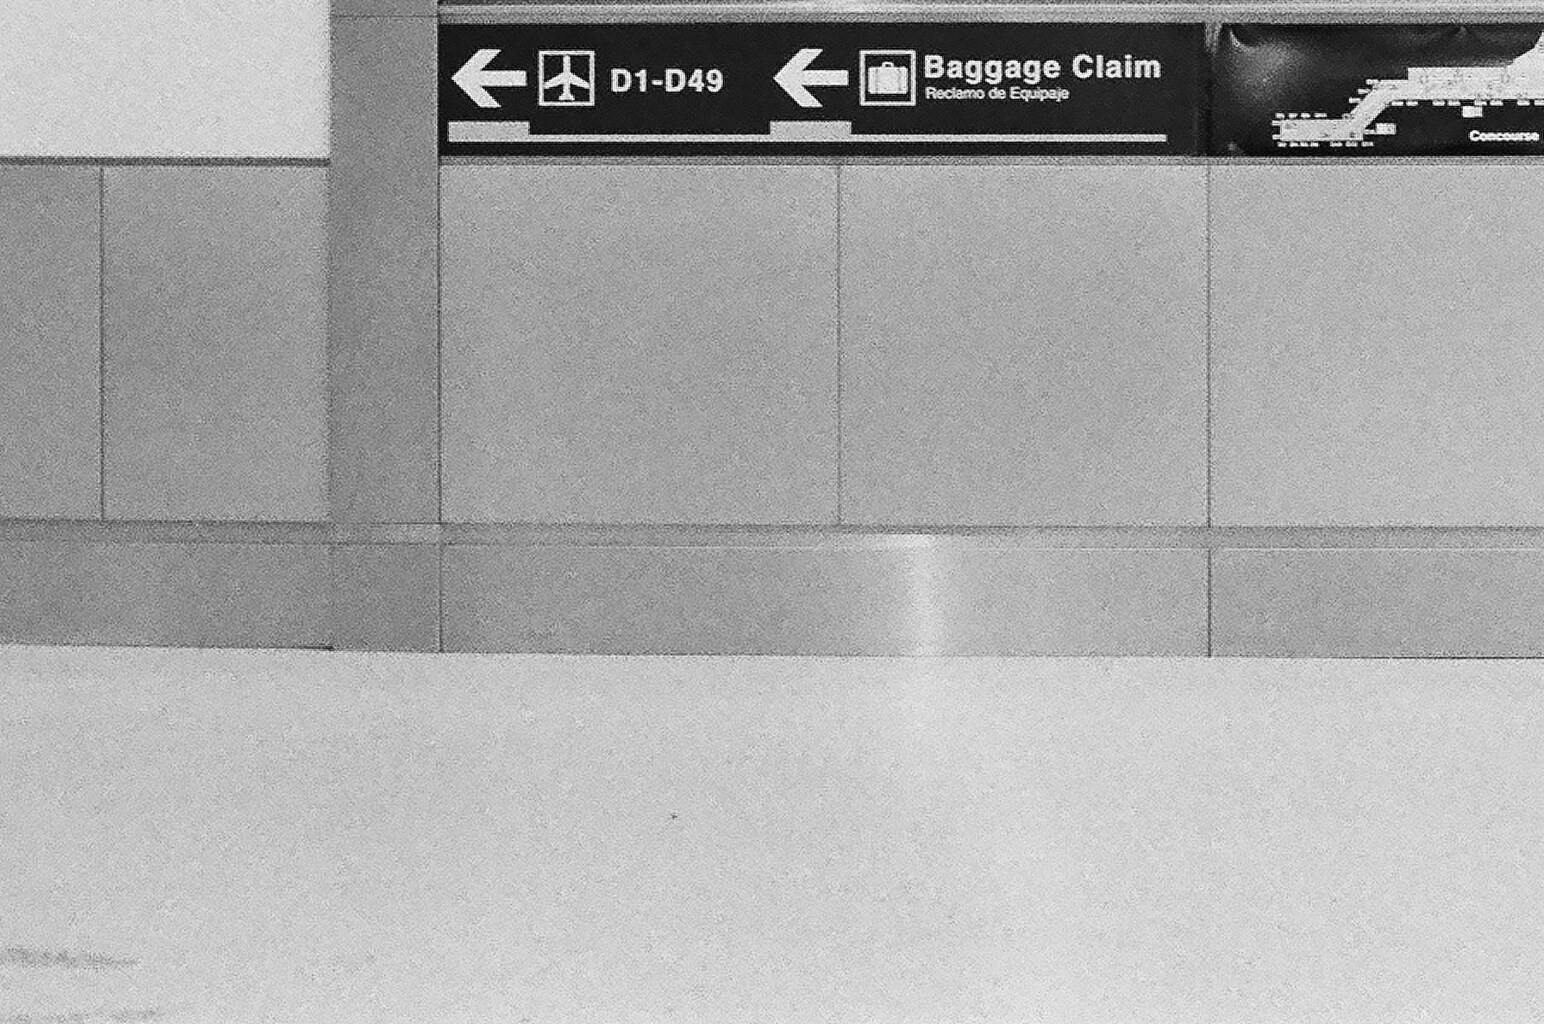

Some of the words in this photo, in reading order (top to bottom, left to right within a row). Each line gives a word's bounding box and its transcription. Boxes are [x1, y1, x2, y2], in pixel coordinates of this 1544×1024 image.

[925, 55, 1060, 84] Baggage
[1073, 54, 1160, 78] Claim
[611, 69, 723, 92] D1-D49
[925, 86, 986, 100] Reclamo
[988, 86, 1007, 100] de
[1009, 86, 1070, 102] Equipaje
[1468, 129, 1540, 142] Concourse
